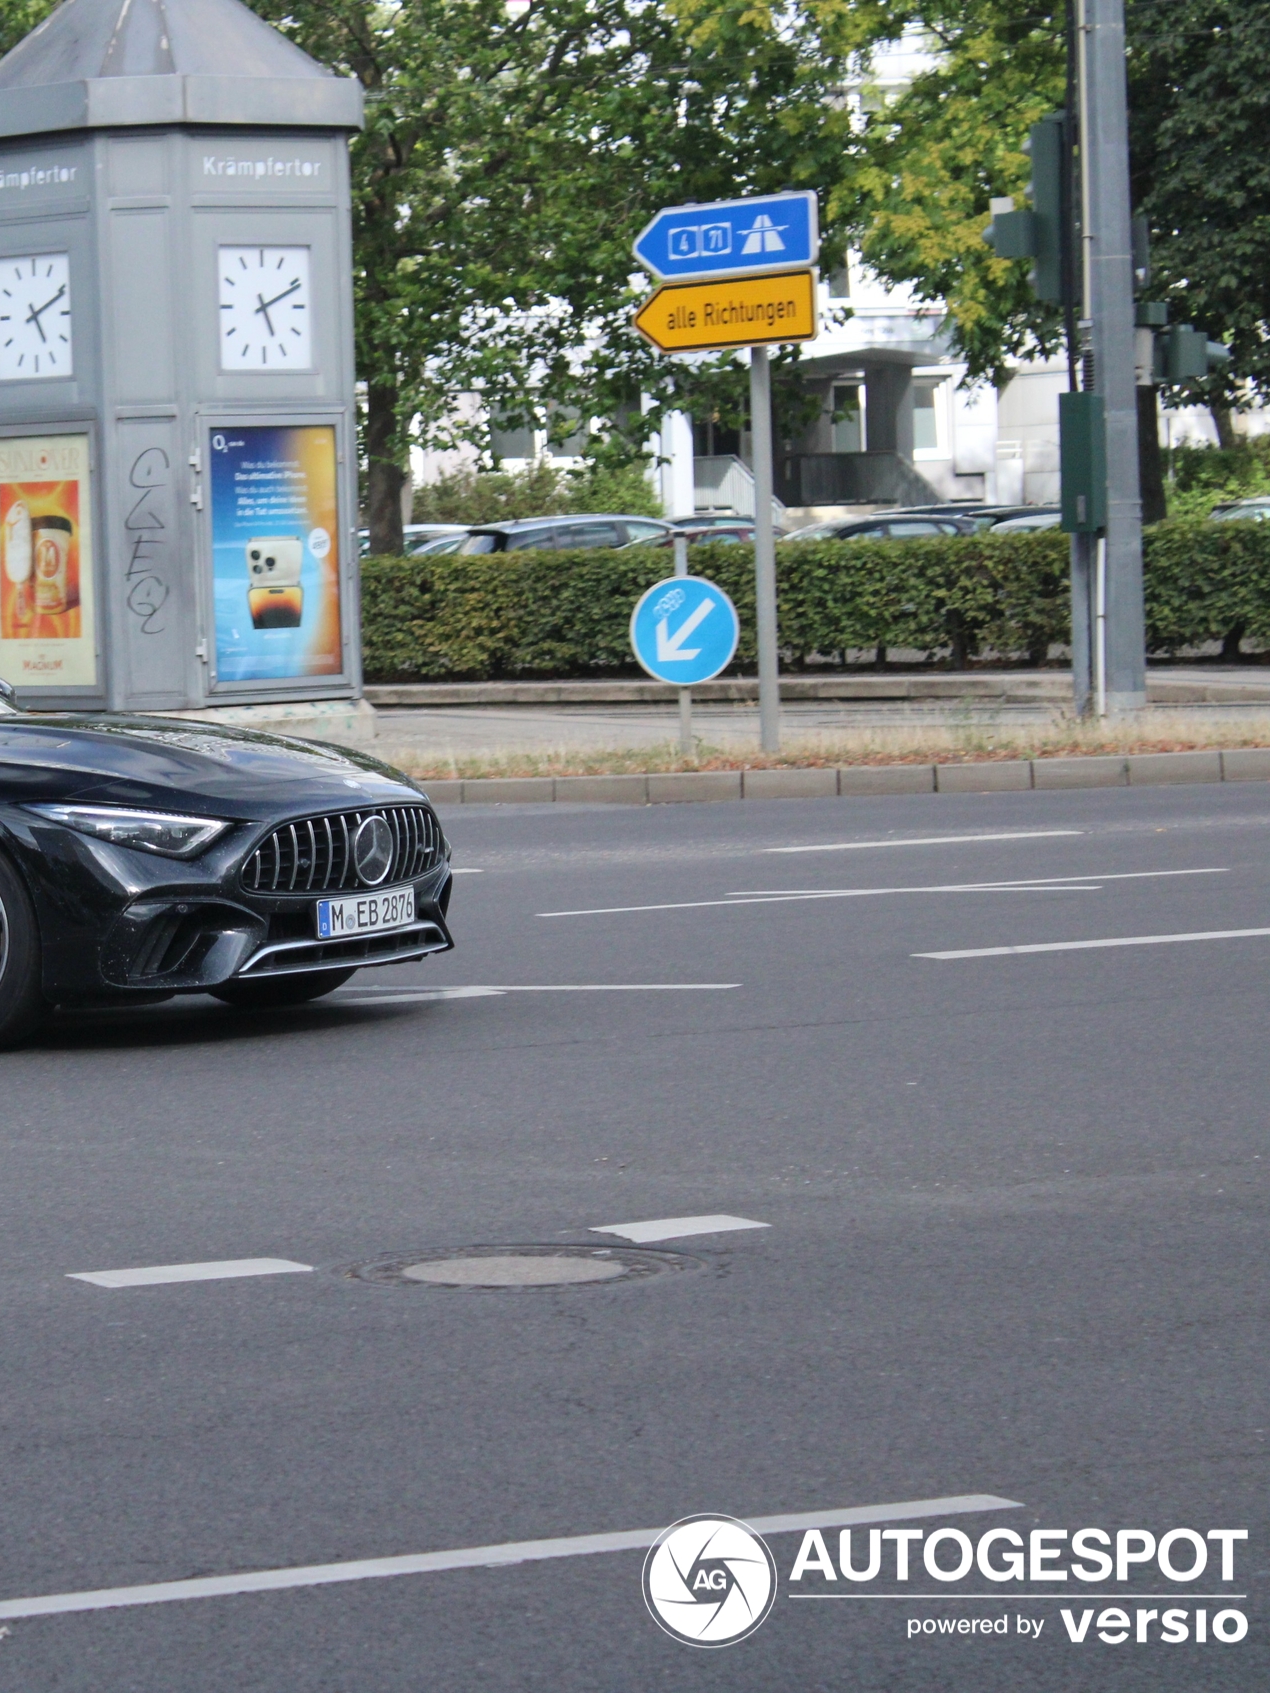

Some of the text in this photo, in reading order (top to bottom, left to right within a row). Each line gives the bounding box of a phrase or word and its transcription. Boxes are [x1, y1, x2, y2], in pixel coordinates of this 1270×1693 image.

[203, 156, 322, 180] Krämpfertor
[679, 230, 724, 252] 4 71
[667, 300, 796, 331] alle Richtungen
[331, 892, 413, 931] M EB 2876
